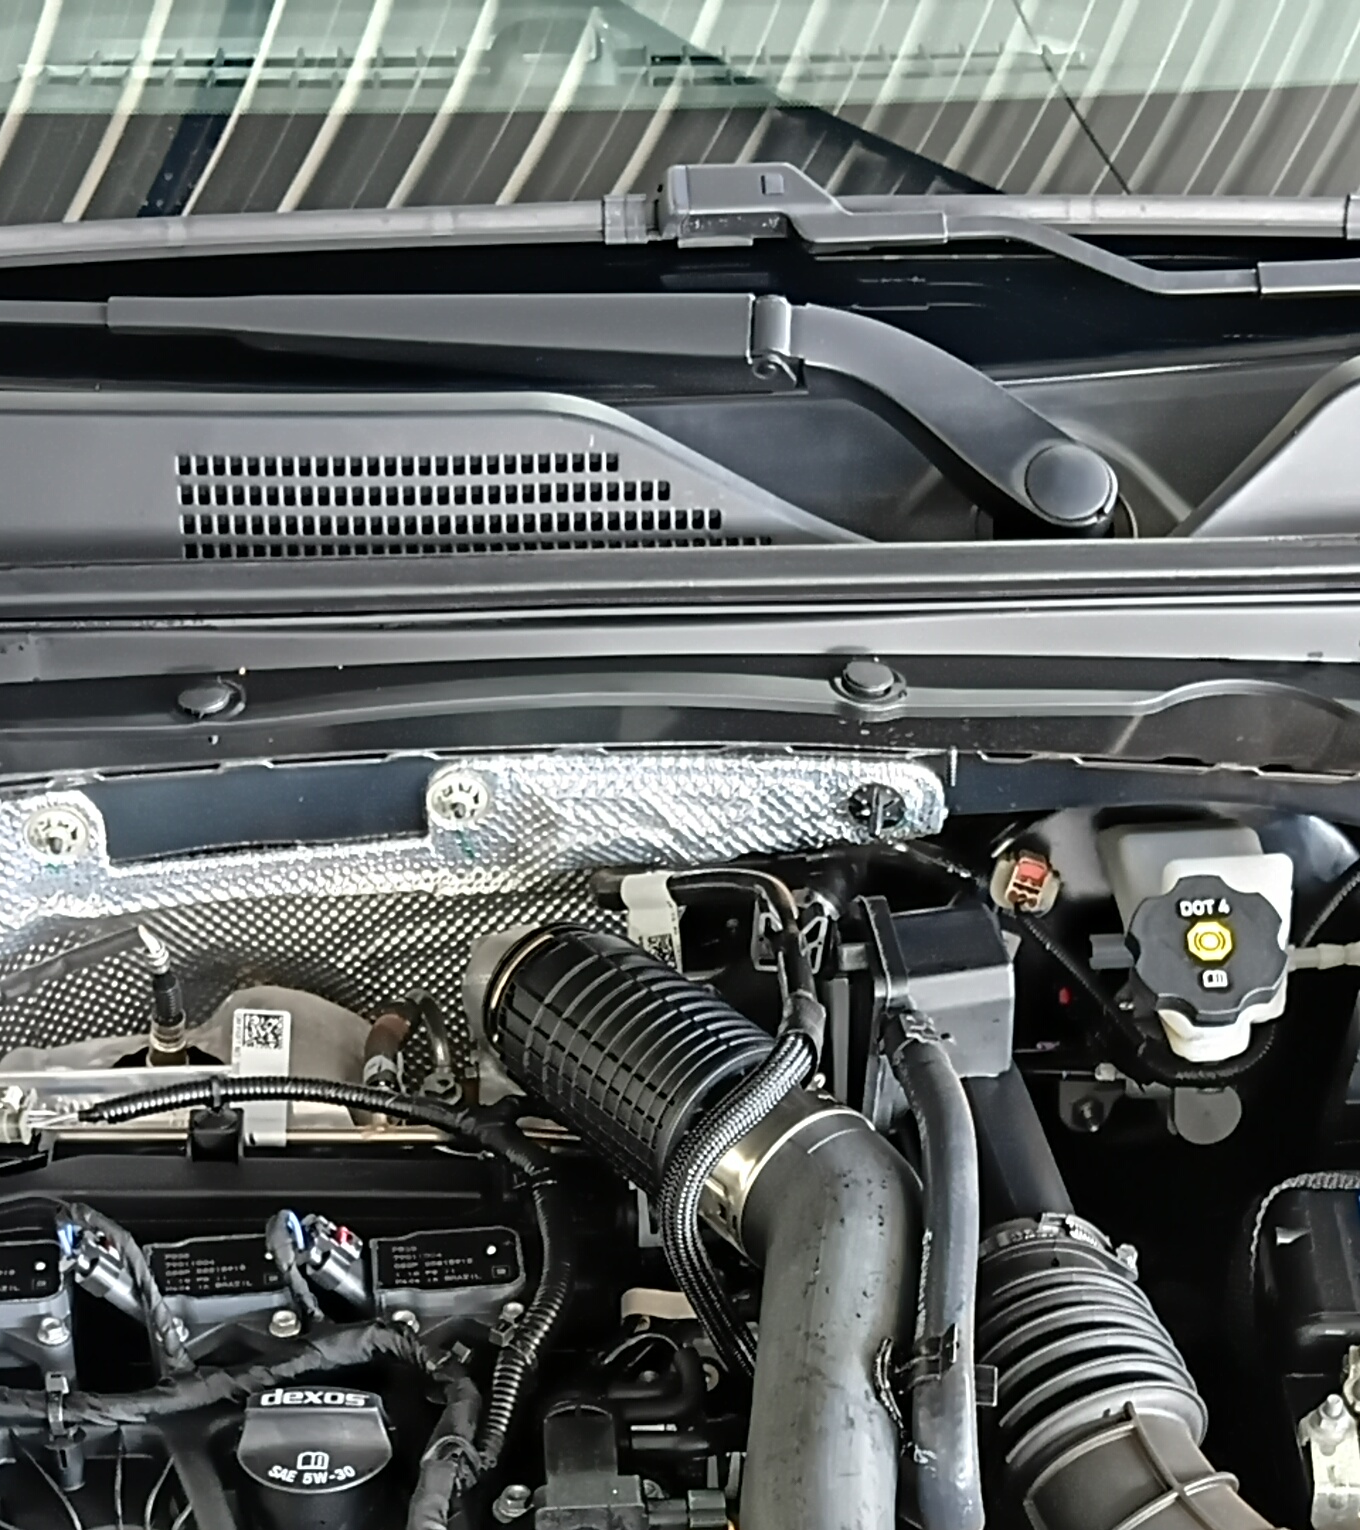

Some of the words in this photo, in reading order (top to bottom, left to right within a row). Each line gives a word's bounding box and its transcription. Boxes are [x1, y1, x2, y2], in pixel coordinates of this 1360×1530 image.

[1179, 899, 1215, 917] DOT
[1218, 898, 1230, 914] 4
[260, 1388, 370, 1407] dexos
[267, 1465, 299, 1483] SAE
[302, 1465, 356, 1485] 5W-30
